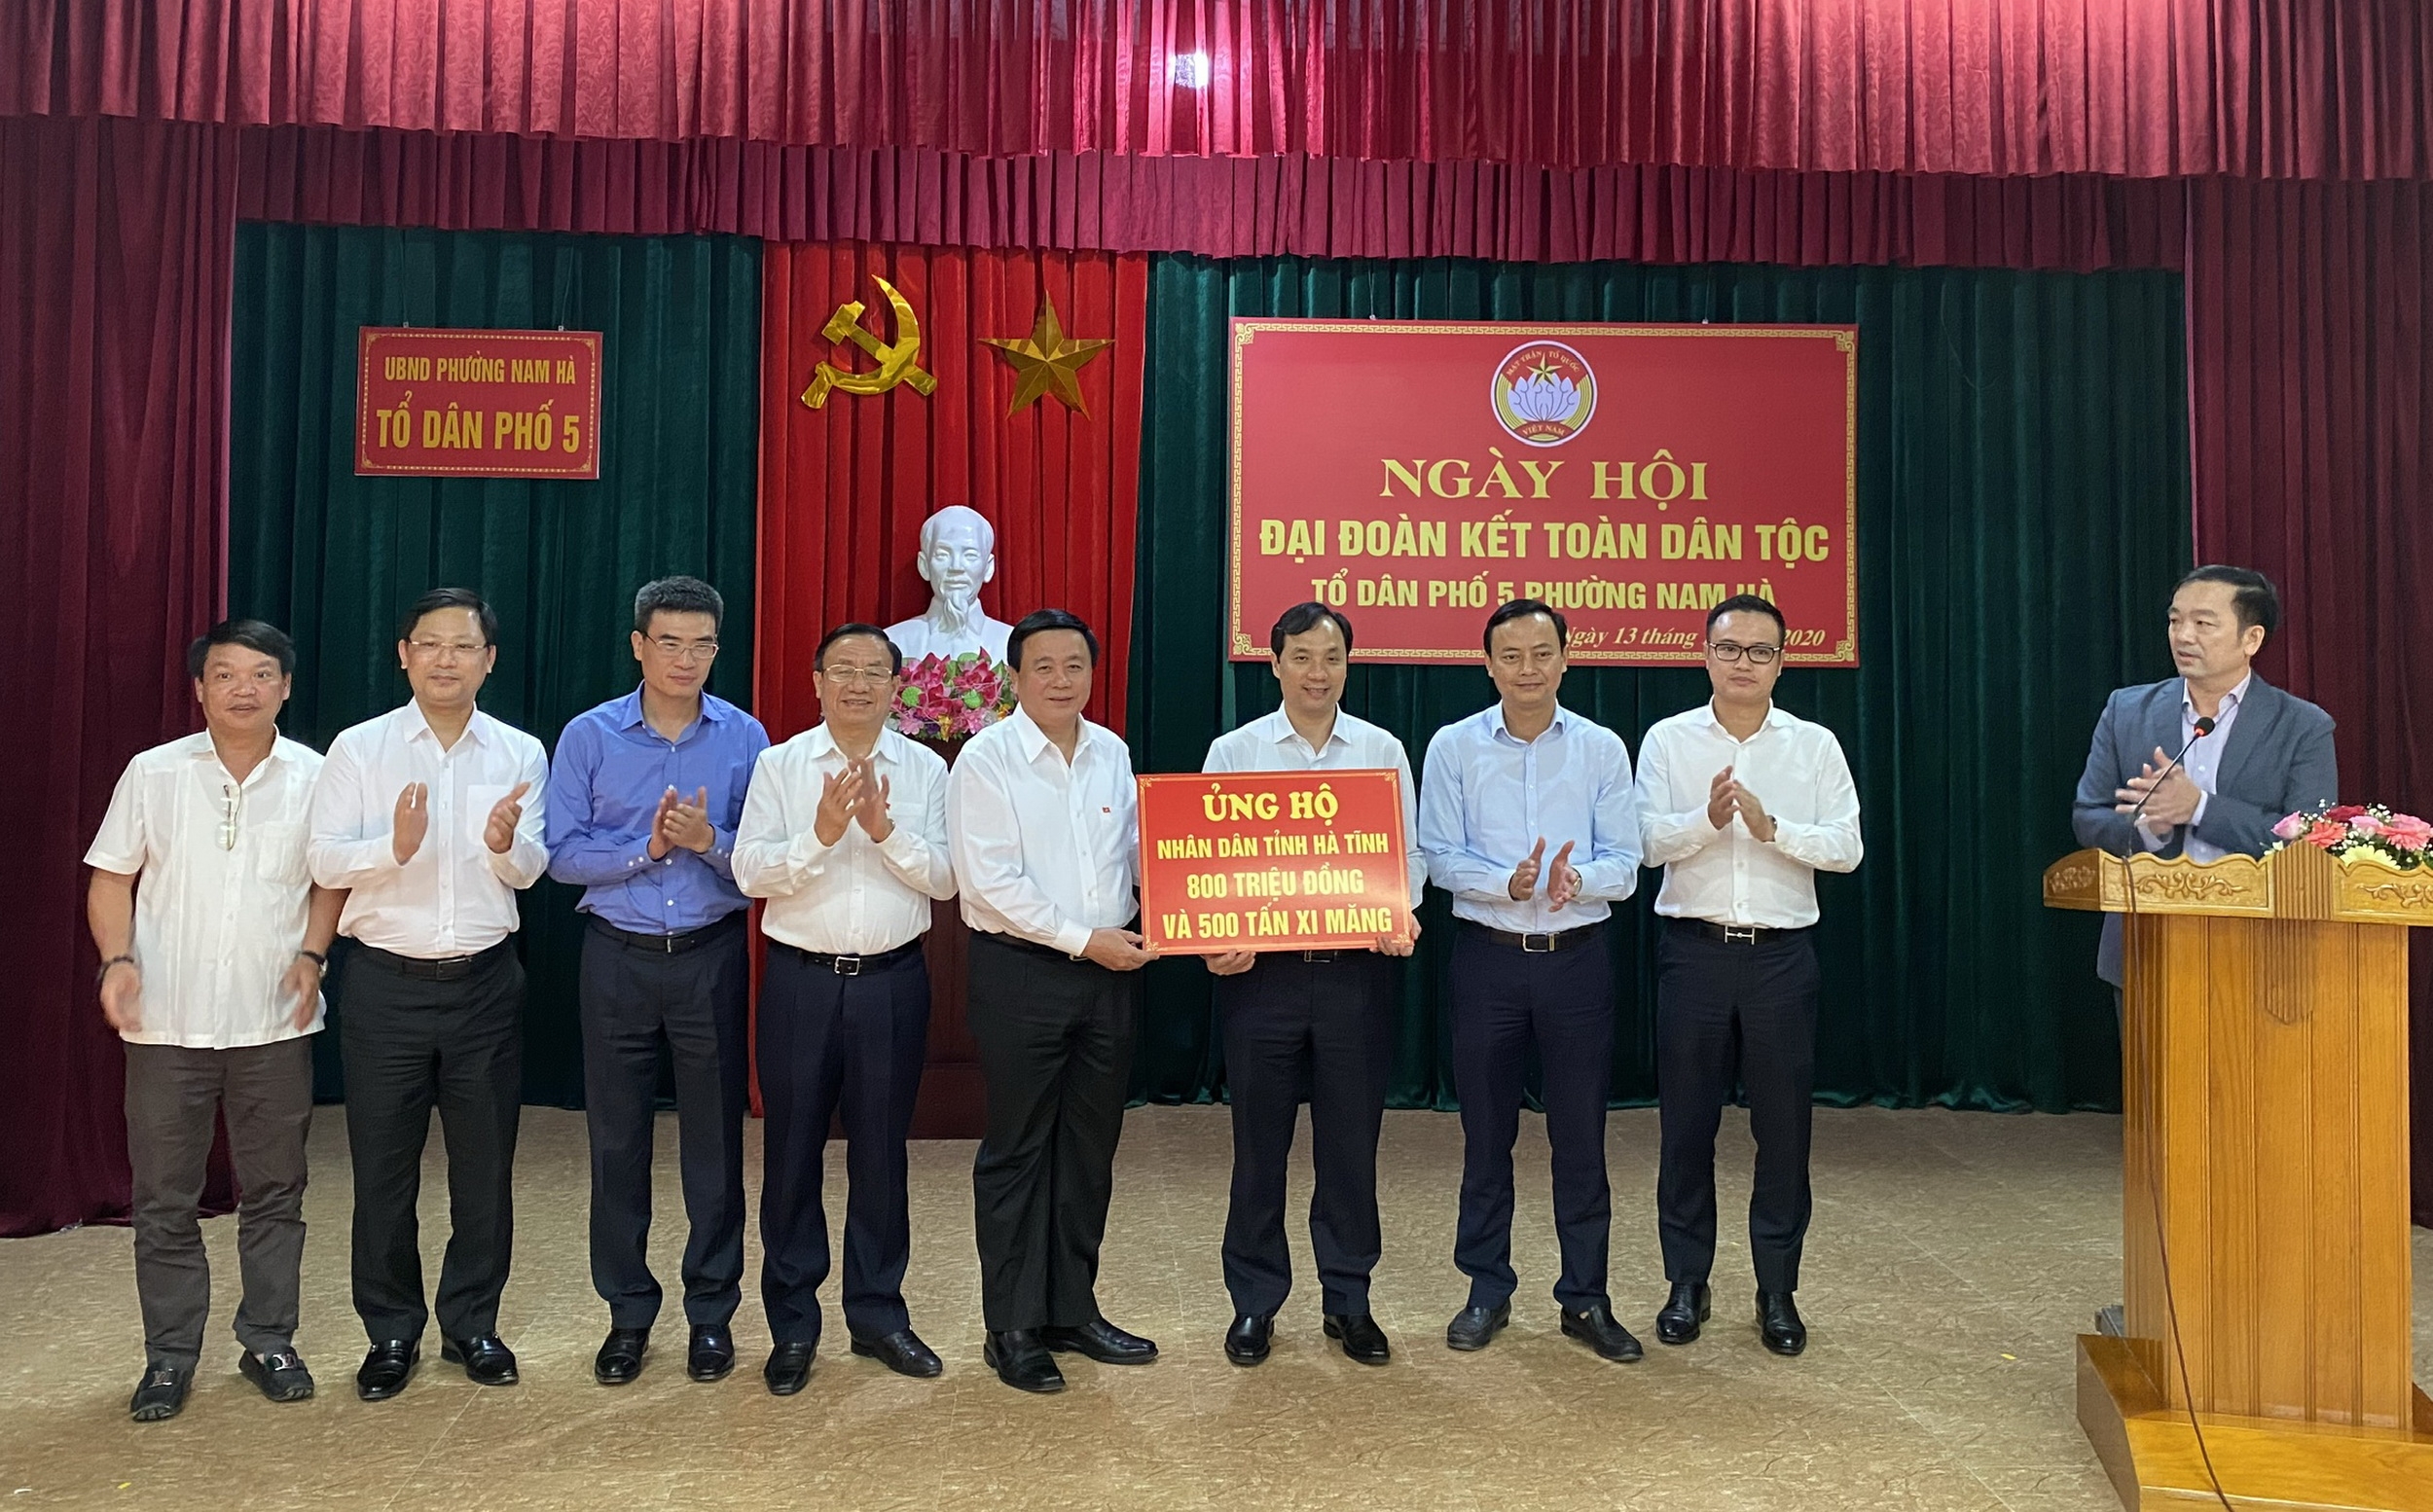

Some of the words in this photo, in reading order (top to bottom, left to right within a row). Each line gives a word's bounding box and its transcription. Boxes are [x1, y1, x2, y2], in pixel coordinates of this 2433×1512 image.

[384, 356, 429, 381] UBND
[437, 350, 504, 382] PHƯỜNG
[511, 359, 550, 383] NAM
[557, 355, 575, 384] HÀ
[377, 390, 413, 449] TỔ
[422, 402, 483, 450] DÂN
[494, 399, 554, 451] PHỐ
[563, 415, 579, 453] 5
[1379, 446, 1564, 498] NGÀY
[1590, 448, 1708, 510] HỘI
[1259, 519, 1325, 563] ĐẠI
[1338, 513, 1446, 558] ĐOÀN
[1461, 509, 1532, 558] KẾT
[1543, 515, 1647, 558] TOÀN
[1660, 516, 1741, 560] DÂN
[1755, 517, 1829, 568] TỘC
[1311, 567, 1348, 606] TỔ
[1358, 573, 1418, 607] DÂN
[1429, 570, 1489, 607] PHỐ
[1497, 581, 1515, 606] 5
[1525, 574, 1647, 609] PHƯỜNG
[1656, 583, 1726, 610] NAM
[1613, 628, 1638, 645] 13
[1641, 628, 1698, 649] tháng
[1202, 782, 1280, 822] ỦNG
[1289, 782, 1339, 826] HỘ
[1157, 834, 1212, 859] NHÂN
[1217, 833, 1258, 858] DÂN
[1263, 829, 1308, 856] TỈNH
[1313, 830, 1340, 855] HÀ
[1344, 830, 1389, 854] TĨNH
[1186, 872, 1227, 899] 800
[1233, 867, 1296, 902] TRIỆU
[1303, 862, 1364, 896] ĐỒNG
[1162, 908, 1192, 940] VÀ
[1198, 912, 1239, 938] 500
[1245, 902, 1289, 936] TẤN
[1295, 909, 1318, 935] XI
[1325, 904, 1393, 933] MĂNG
